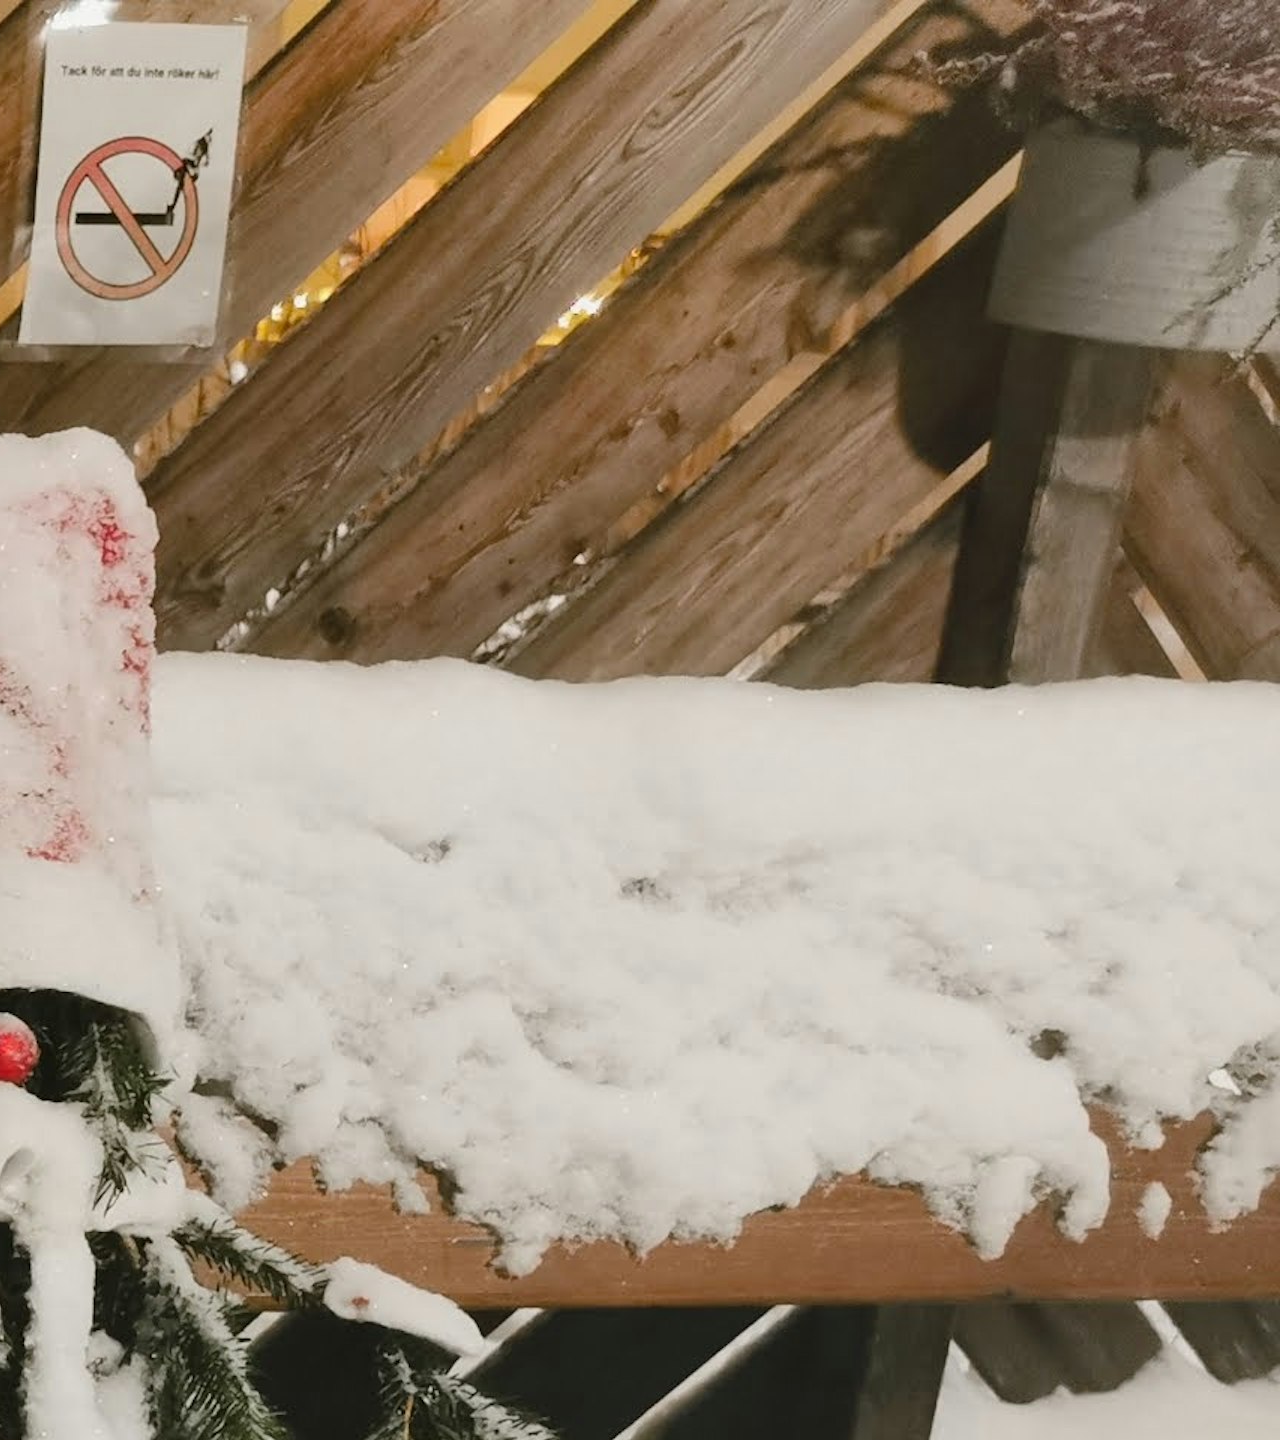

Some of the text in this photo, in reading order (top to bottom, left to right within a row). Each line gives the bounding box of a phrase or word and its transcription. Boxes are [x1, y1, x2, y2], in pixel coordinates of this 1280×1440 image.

[61, 65, 87, 77] Tack
[127, 66, 141, 78] du
[144, 66, 164, 78] inte
